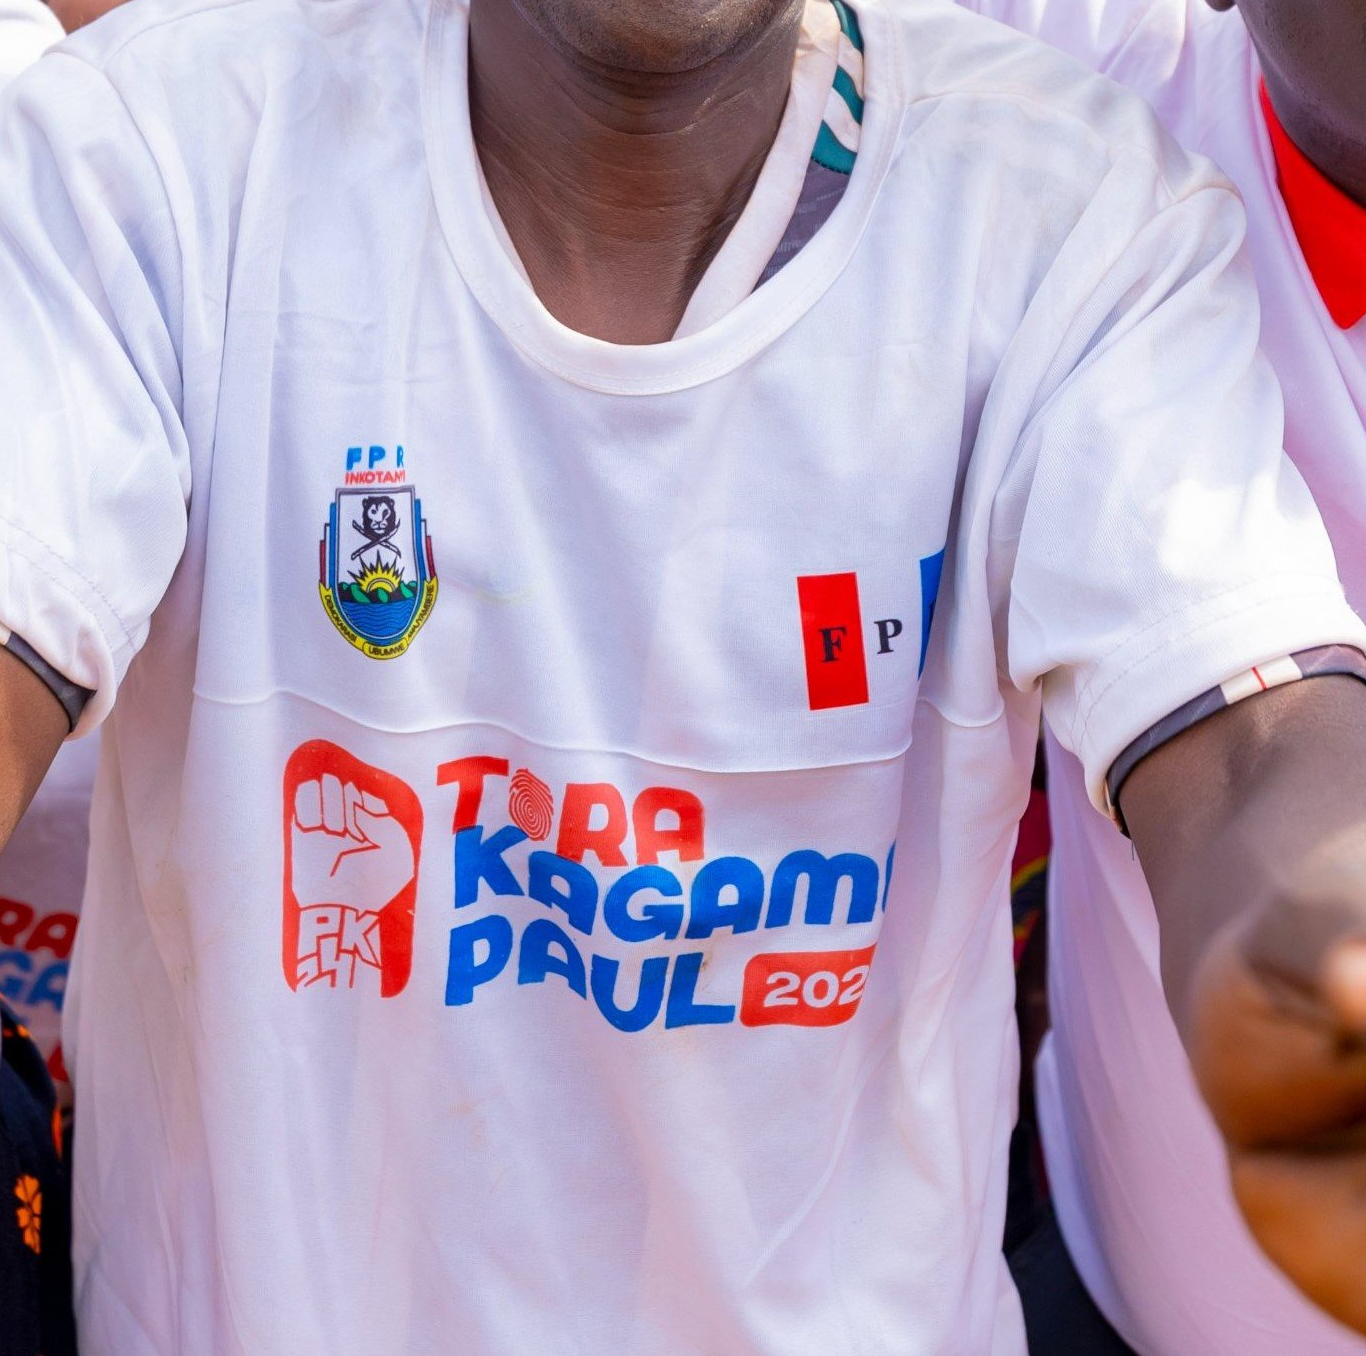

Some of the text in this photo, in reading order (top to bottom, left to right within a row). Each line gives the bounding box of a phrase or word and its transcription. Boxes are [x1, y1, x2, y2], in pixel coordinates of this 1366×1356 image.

[819, 618, 903, 662] F P
[436, 755, 706, 867] TORA
[454, 824, 897, 943] KAGAM
[445, 914, 870, 1033] PAUL 202
